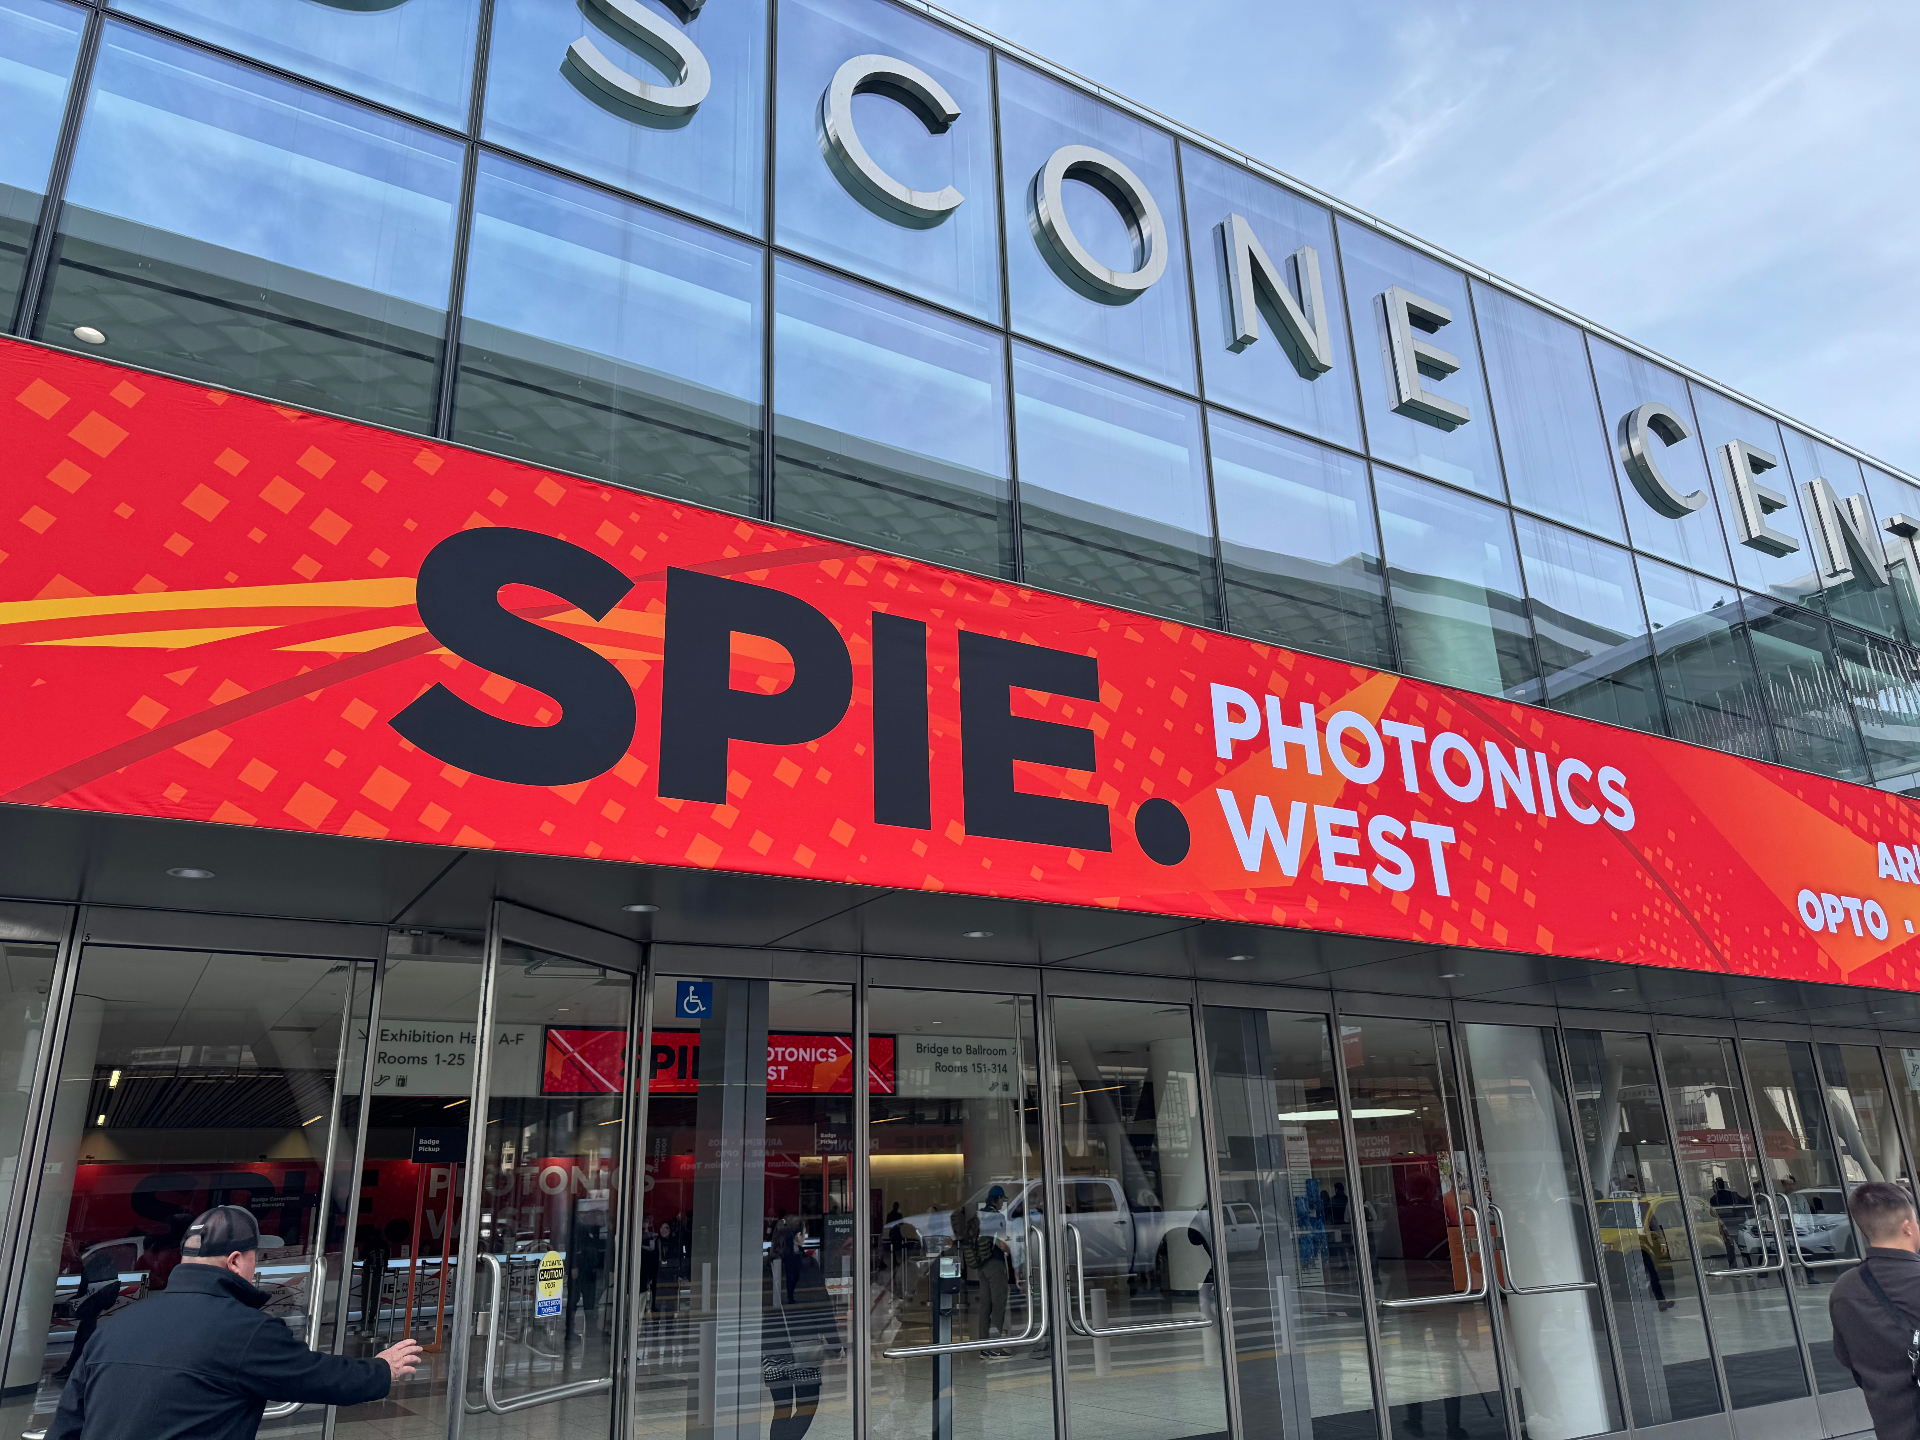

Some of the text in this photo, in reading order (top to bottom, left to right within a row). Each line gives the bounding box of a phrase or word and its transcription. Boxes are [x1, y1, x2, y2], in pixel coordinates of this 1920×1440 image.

[300, 0, 1470, 431] SCONE
[387, 526, 1191, 867] SPIE.
[1210, 683, 1636, 832] PHOTONICS
[1215, 787, 1456, 897] WEST
[1797, 888, 1889, 941] OPTO
[380, 1029, 454, 1044] Exhibition
[498, 1033, 525, 1046] A-F
[767, 1047, 838, 1063] OTONICS
[916, 1042, 1008, 1057] Bridge to Ballroom
[377, 1051, 466, 1067] Rooms 1-25
[767, 1065, 789, 1081] ST
[934, 1061, 1008, 1074] Rooms 151-314
[418, 1138, 440, 1147] Badge
[820, 1132, 837, 1140] Badge
[418, 1145, 441, 1153] Pickup
[827, 1218, 853, 1226] Exhibitio
[834, 1226, 851, 1234] Maps
[540, 1269, 562, 1280] CAUTION
